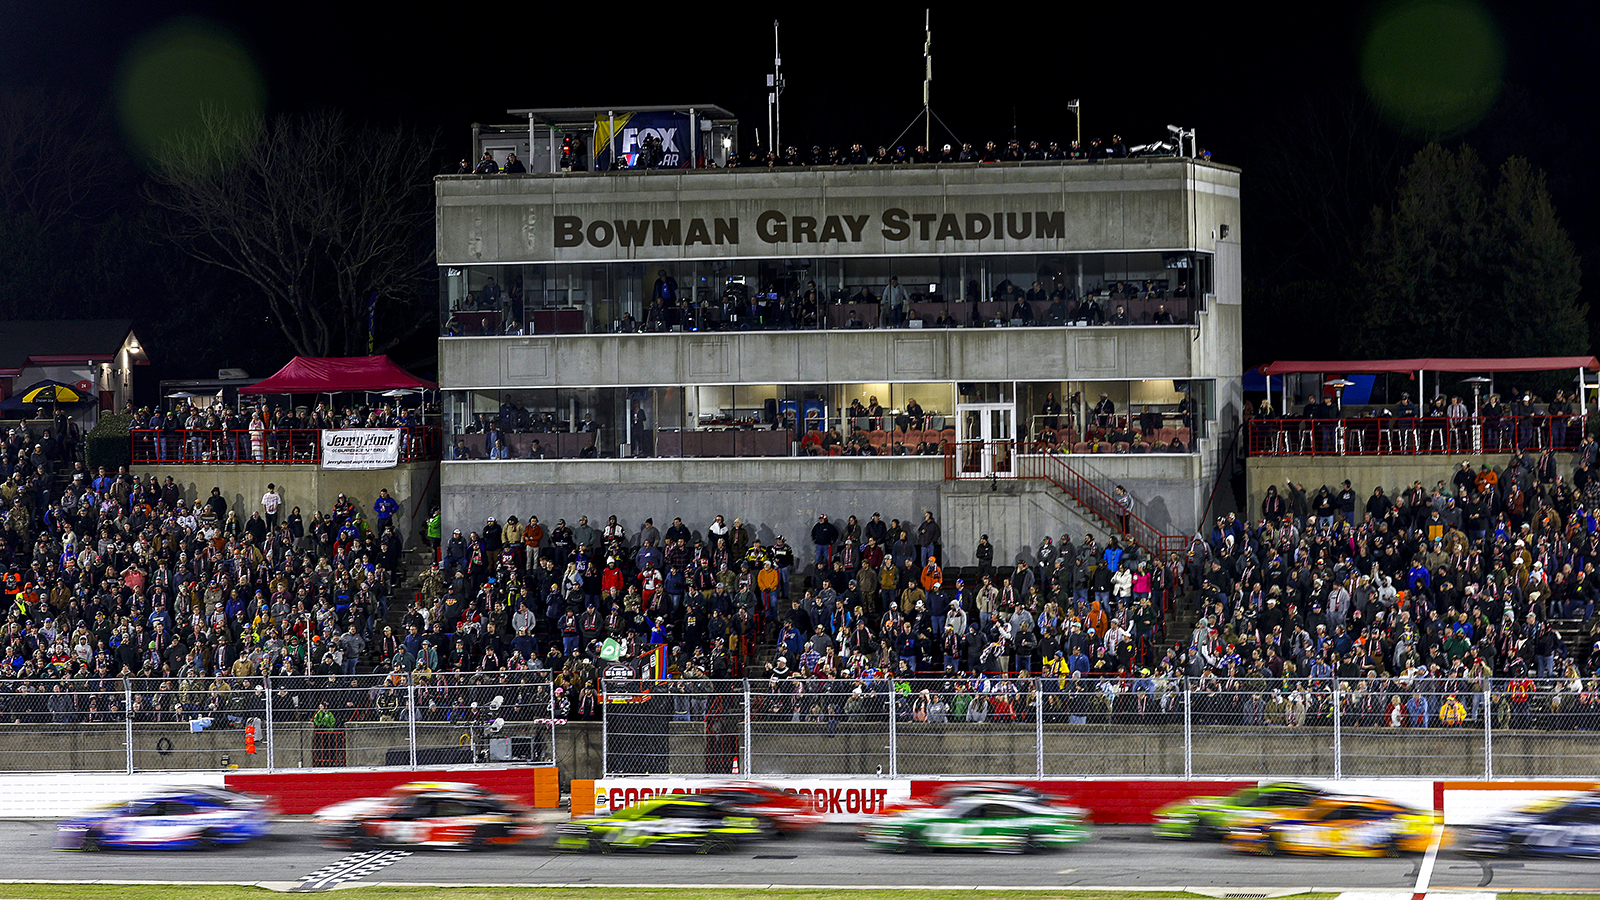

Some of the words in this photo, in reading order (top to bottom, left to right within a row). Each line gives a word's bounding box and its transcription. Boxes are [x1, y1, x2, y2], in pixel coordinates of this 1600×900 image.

[622, 127, 680, 153] FOX
[553, 215, 739, 248] BOWMAN
[756, 209, 870, 244] GRAY
[881, 207, 1066, 242] STADIUM
[327, 434, 363, 448] Jerry
[364, 433, 395, 446] Hunt
[784, 788, 843, 814] OOK
[846, 788, 888, 814] OUT
